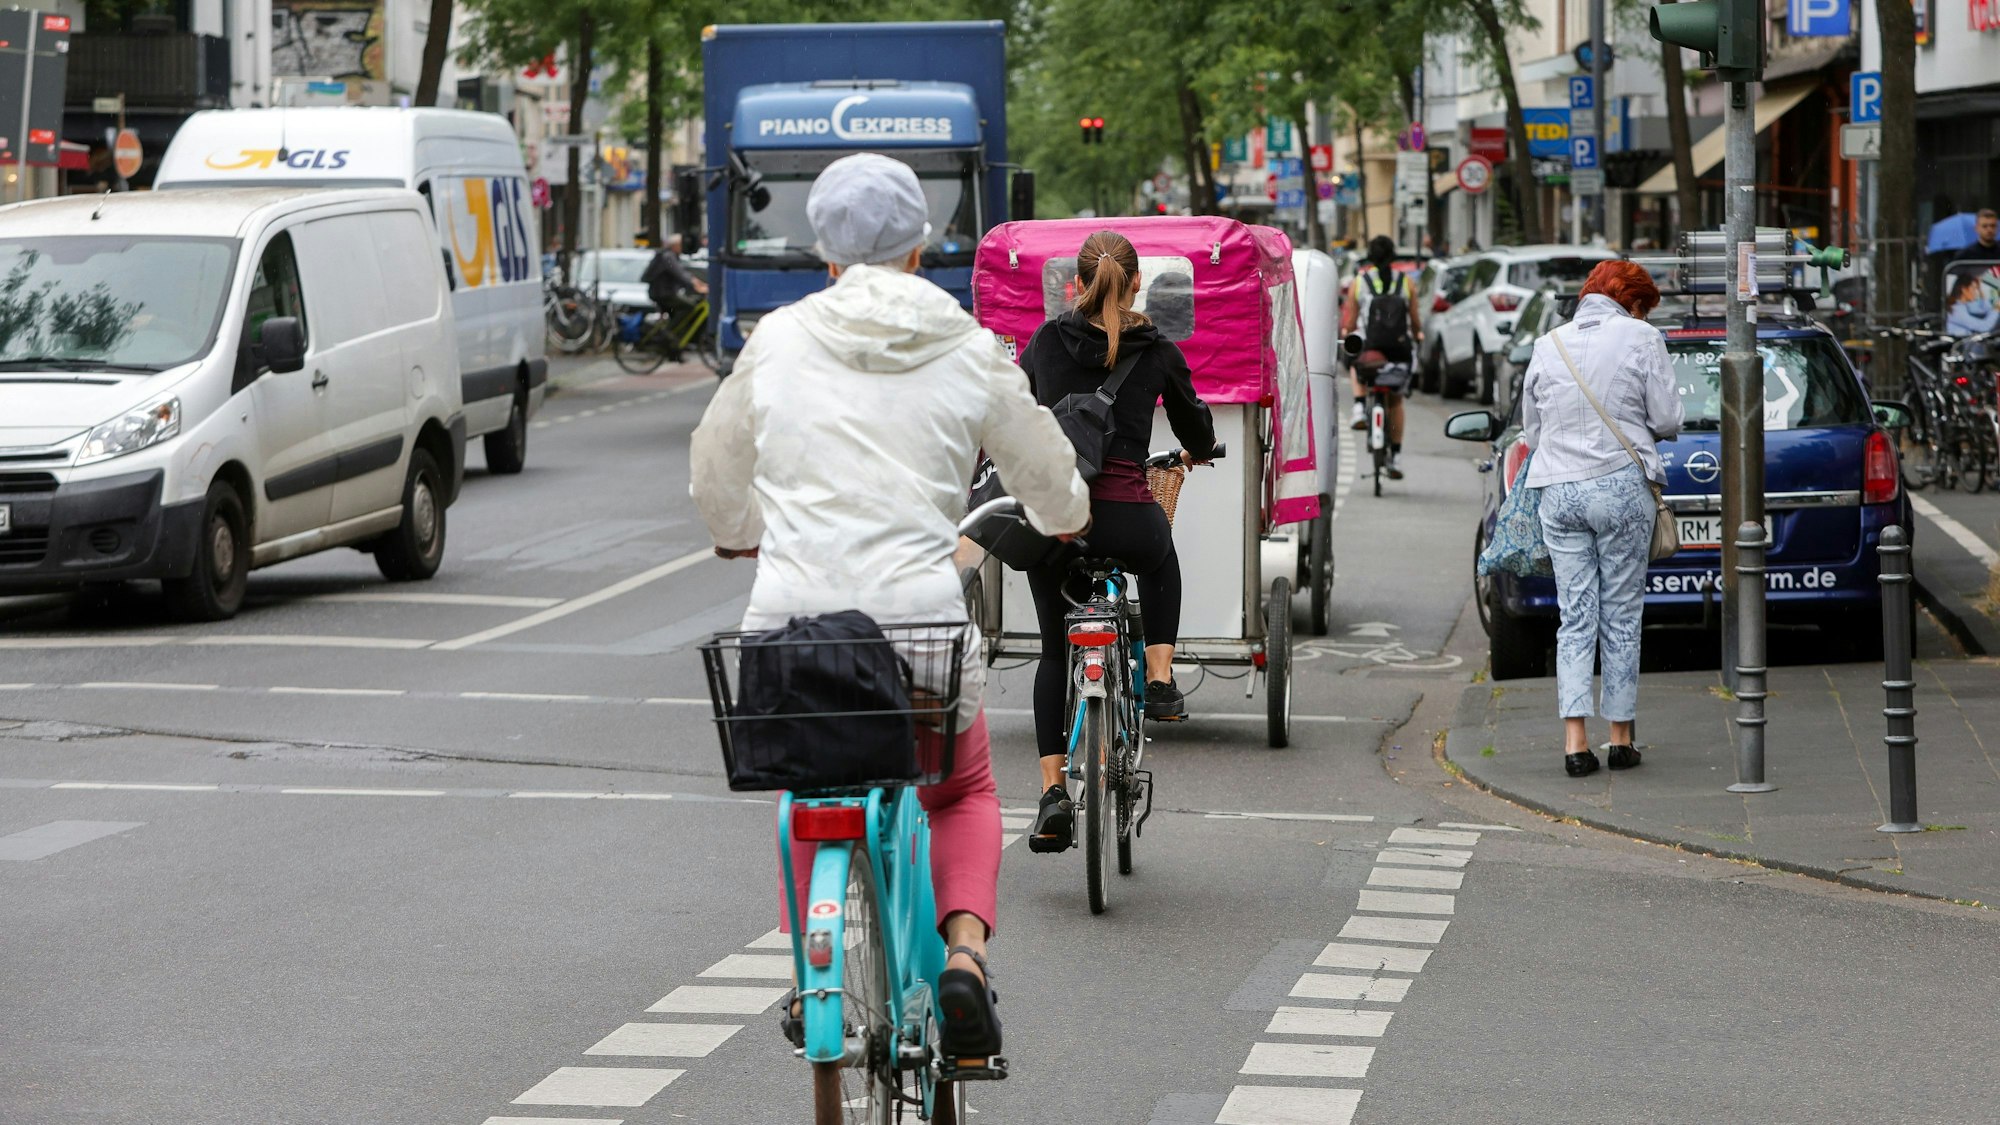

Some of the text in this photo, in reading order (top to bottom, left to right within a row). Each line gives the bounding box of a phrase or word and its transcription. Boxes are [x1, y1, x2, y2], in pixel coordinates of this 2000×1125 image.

[1799, 0, 1839, 33] P
[1572, 80, 1587, 106] P
[1859, 77, 1881, 117] P
[850, 117, 952, 134] EXPRESS
[286, 149, 350, 169] GLS
[1574, 139, 1590, 166] P
[492, 176, 529, 283] GLS
[1682, 520, 1709, 541] RM
